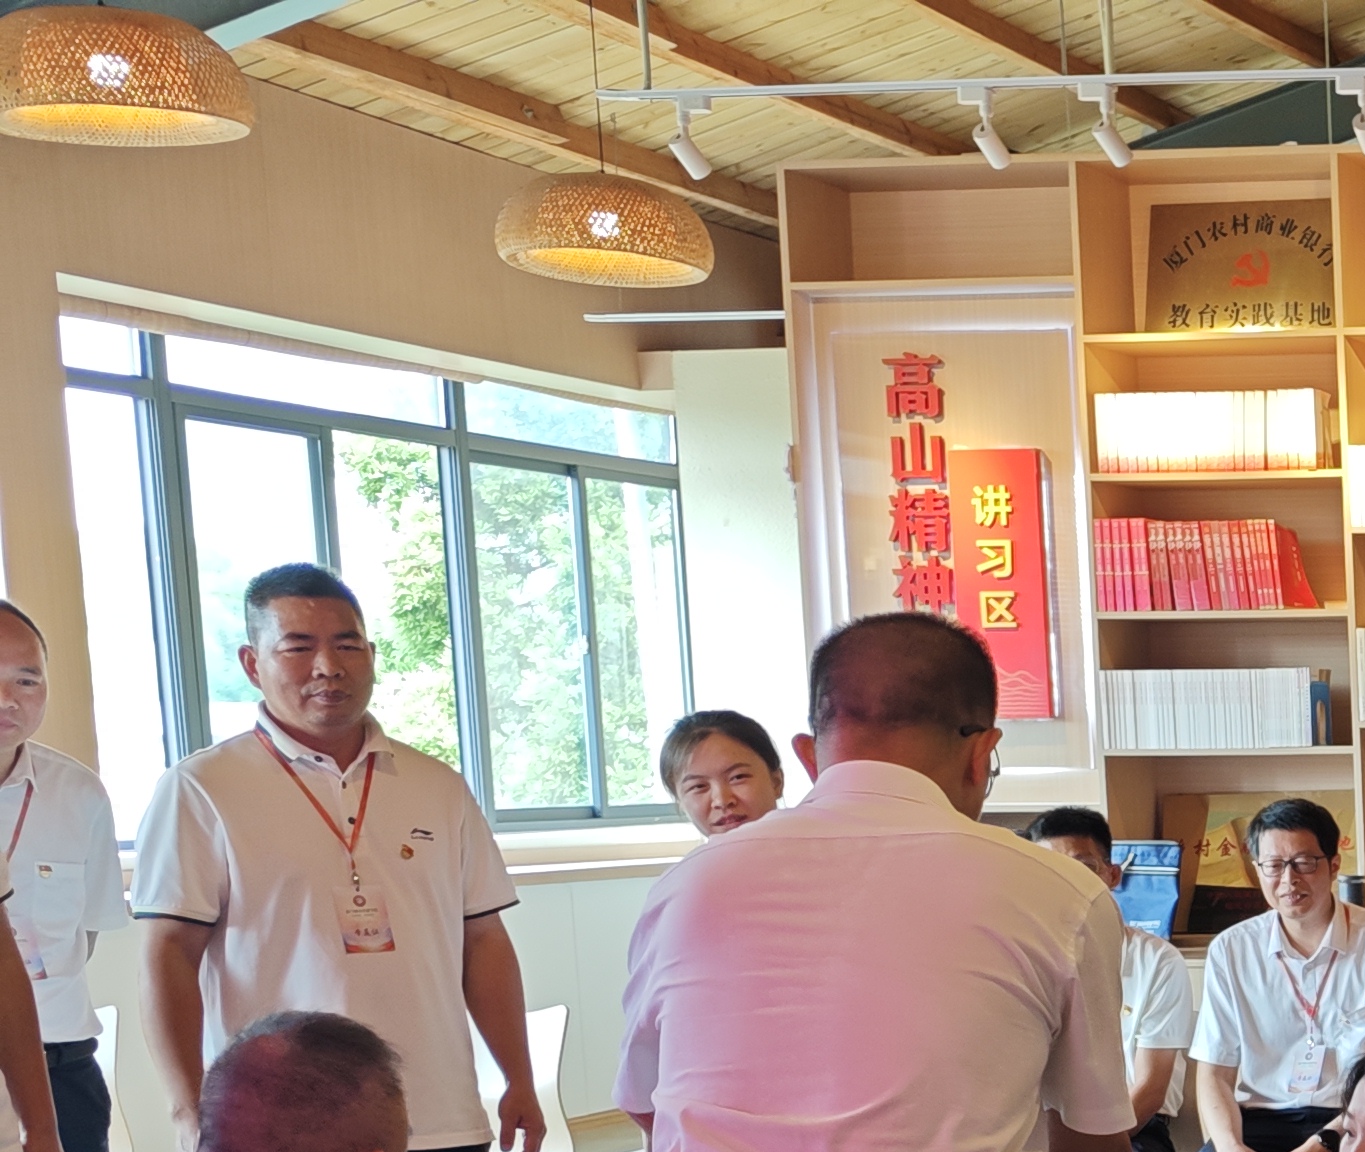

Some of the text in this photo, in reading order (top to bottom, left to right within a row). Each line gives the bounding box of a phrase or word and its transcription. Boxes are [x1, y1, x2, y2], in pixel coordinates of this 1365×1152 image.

[1162, 212, 1334, 273] 厦门农村商业银行
[1167, 301, 1333, 329] 教育实践基地
[881, 352, 956, 612] 高山精神
[970, 485, 1019, 629] 讲习区
